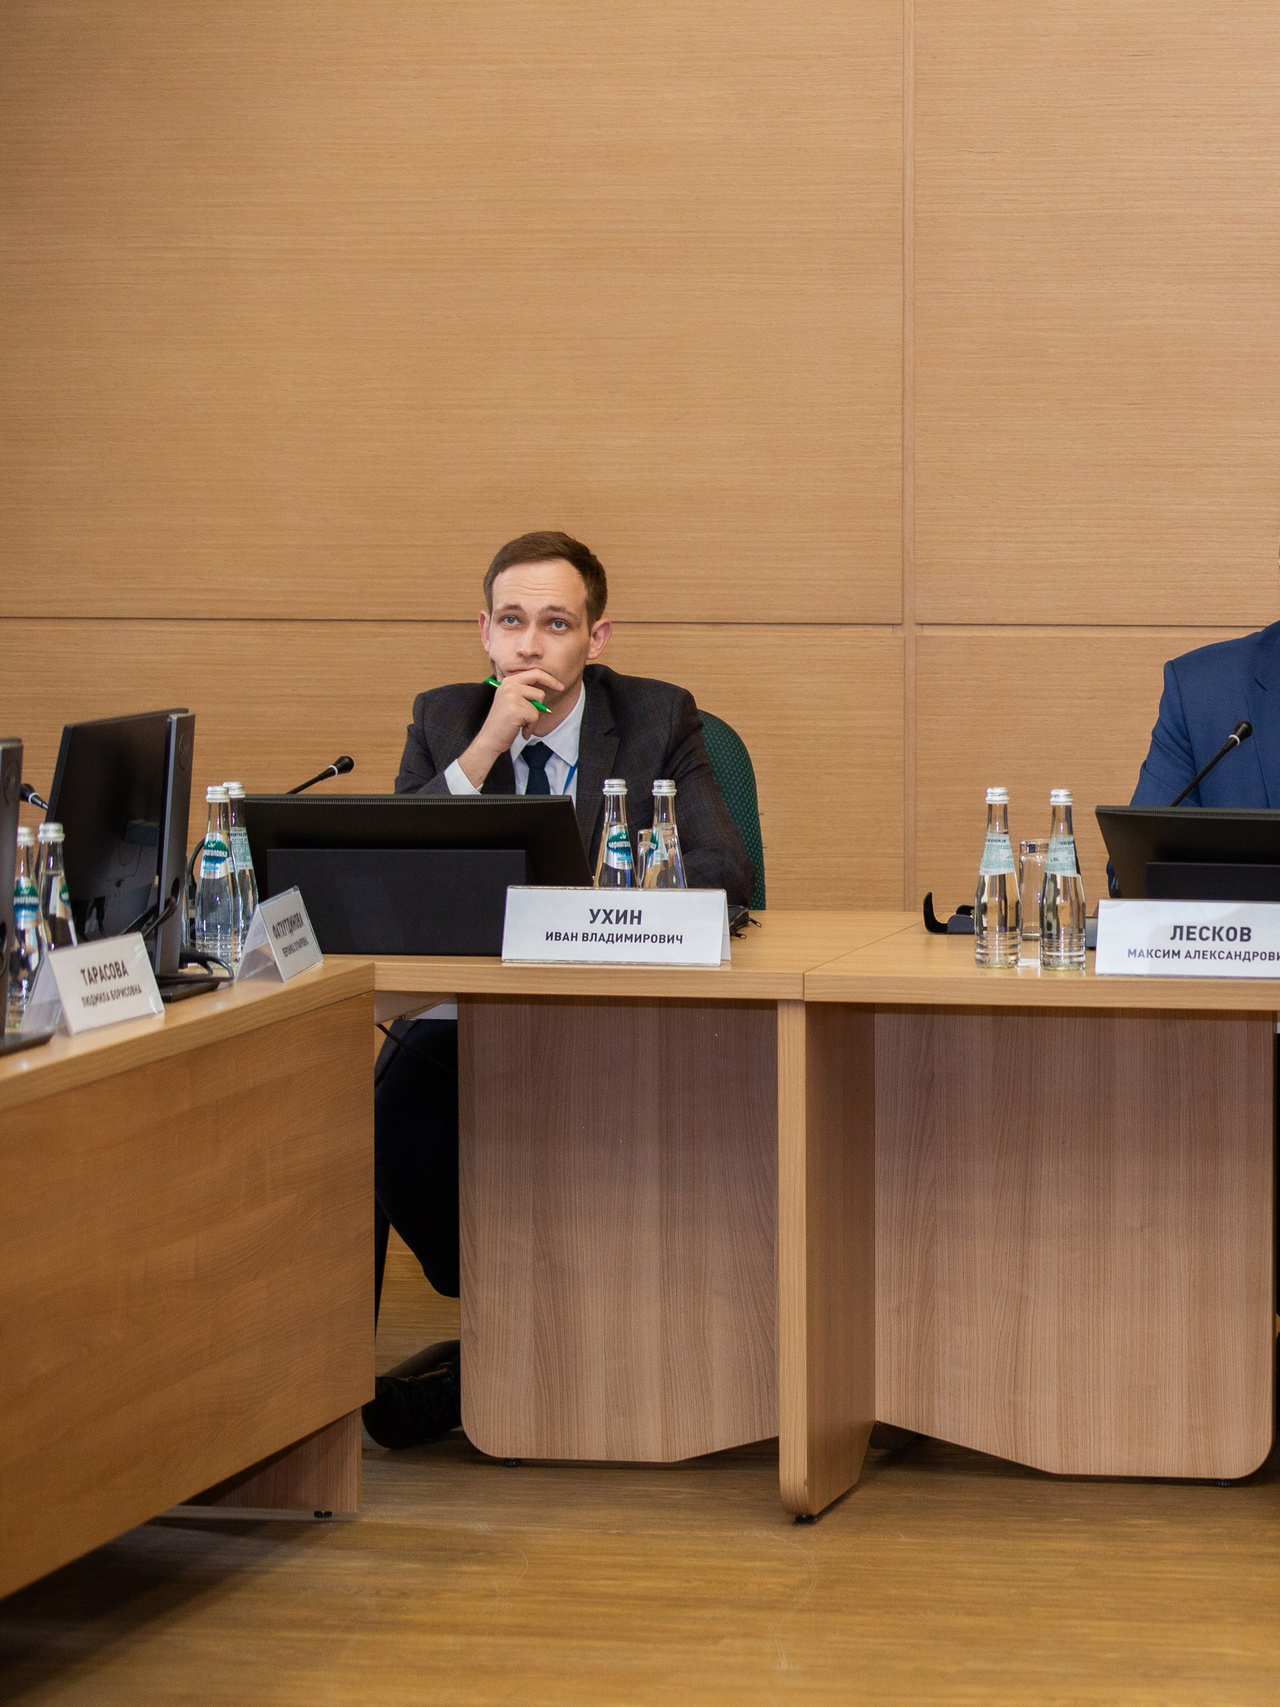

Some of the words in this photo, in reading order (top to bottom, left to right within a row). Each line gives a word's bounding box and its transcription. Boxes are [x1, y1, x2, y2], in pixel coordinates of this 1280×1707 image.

[589, 908, 643, 926] УХИН
[545, 931, 579, 942] ИВАН
[581, 932, 684, 945] ВЛАДИМИРОВИЧ
[1170, 925, 1252, 943] ЛЕСКОВ
[1127, 948, 1181, 959] МАКСИМ
[80, 959, 130, 987] ТАРАСОВА
